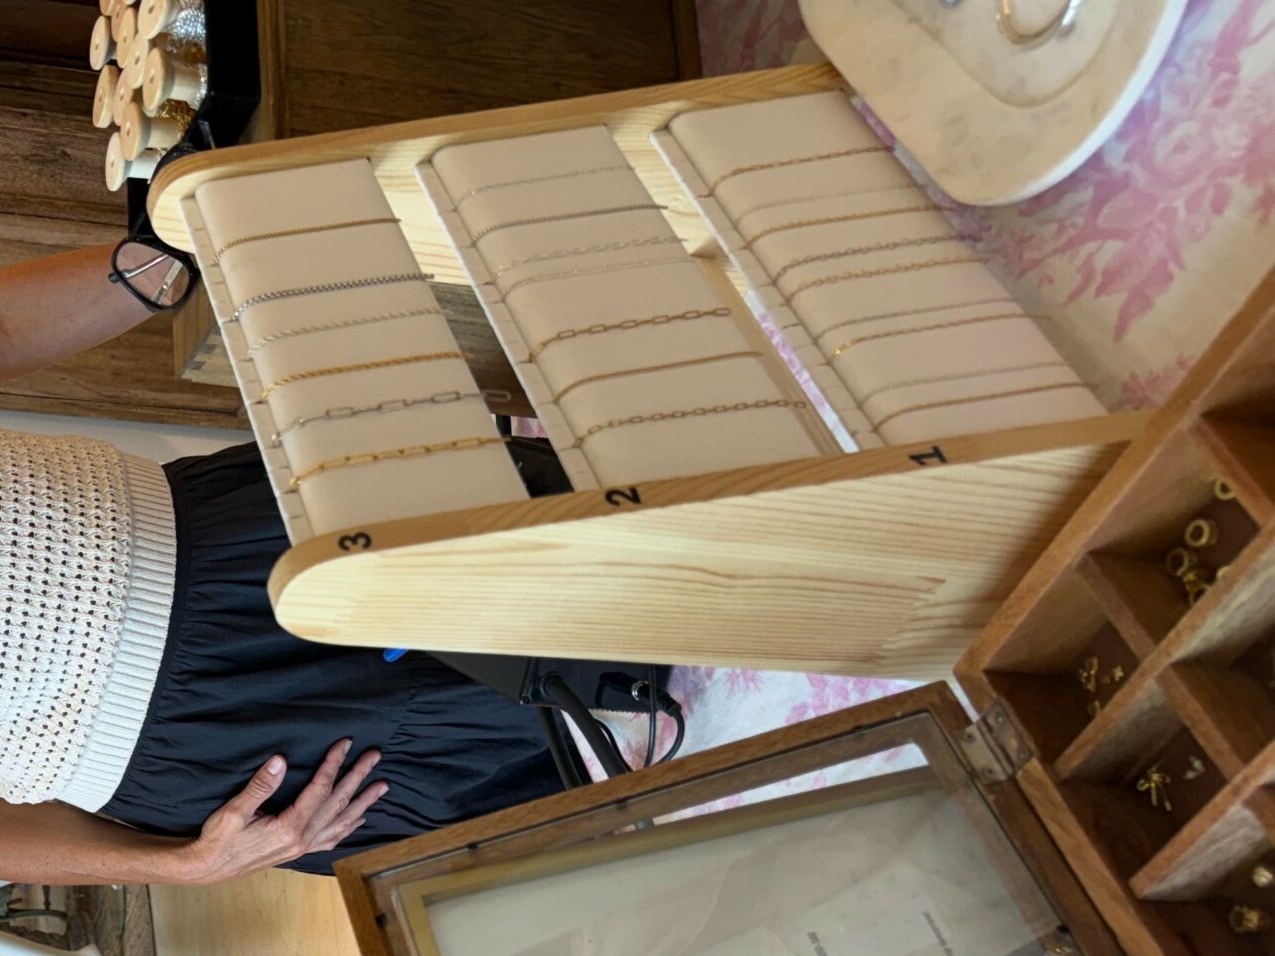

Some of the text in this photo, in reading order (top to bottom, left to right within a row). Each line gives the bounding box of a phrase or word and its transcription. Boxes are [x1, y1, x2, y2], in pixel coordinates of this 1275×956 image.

[909, 446, 947, 468] 1
[605, 486, 641, 507] 2
[339, 532, 371, 552] 3
